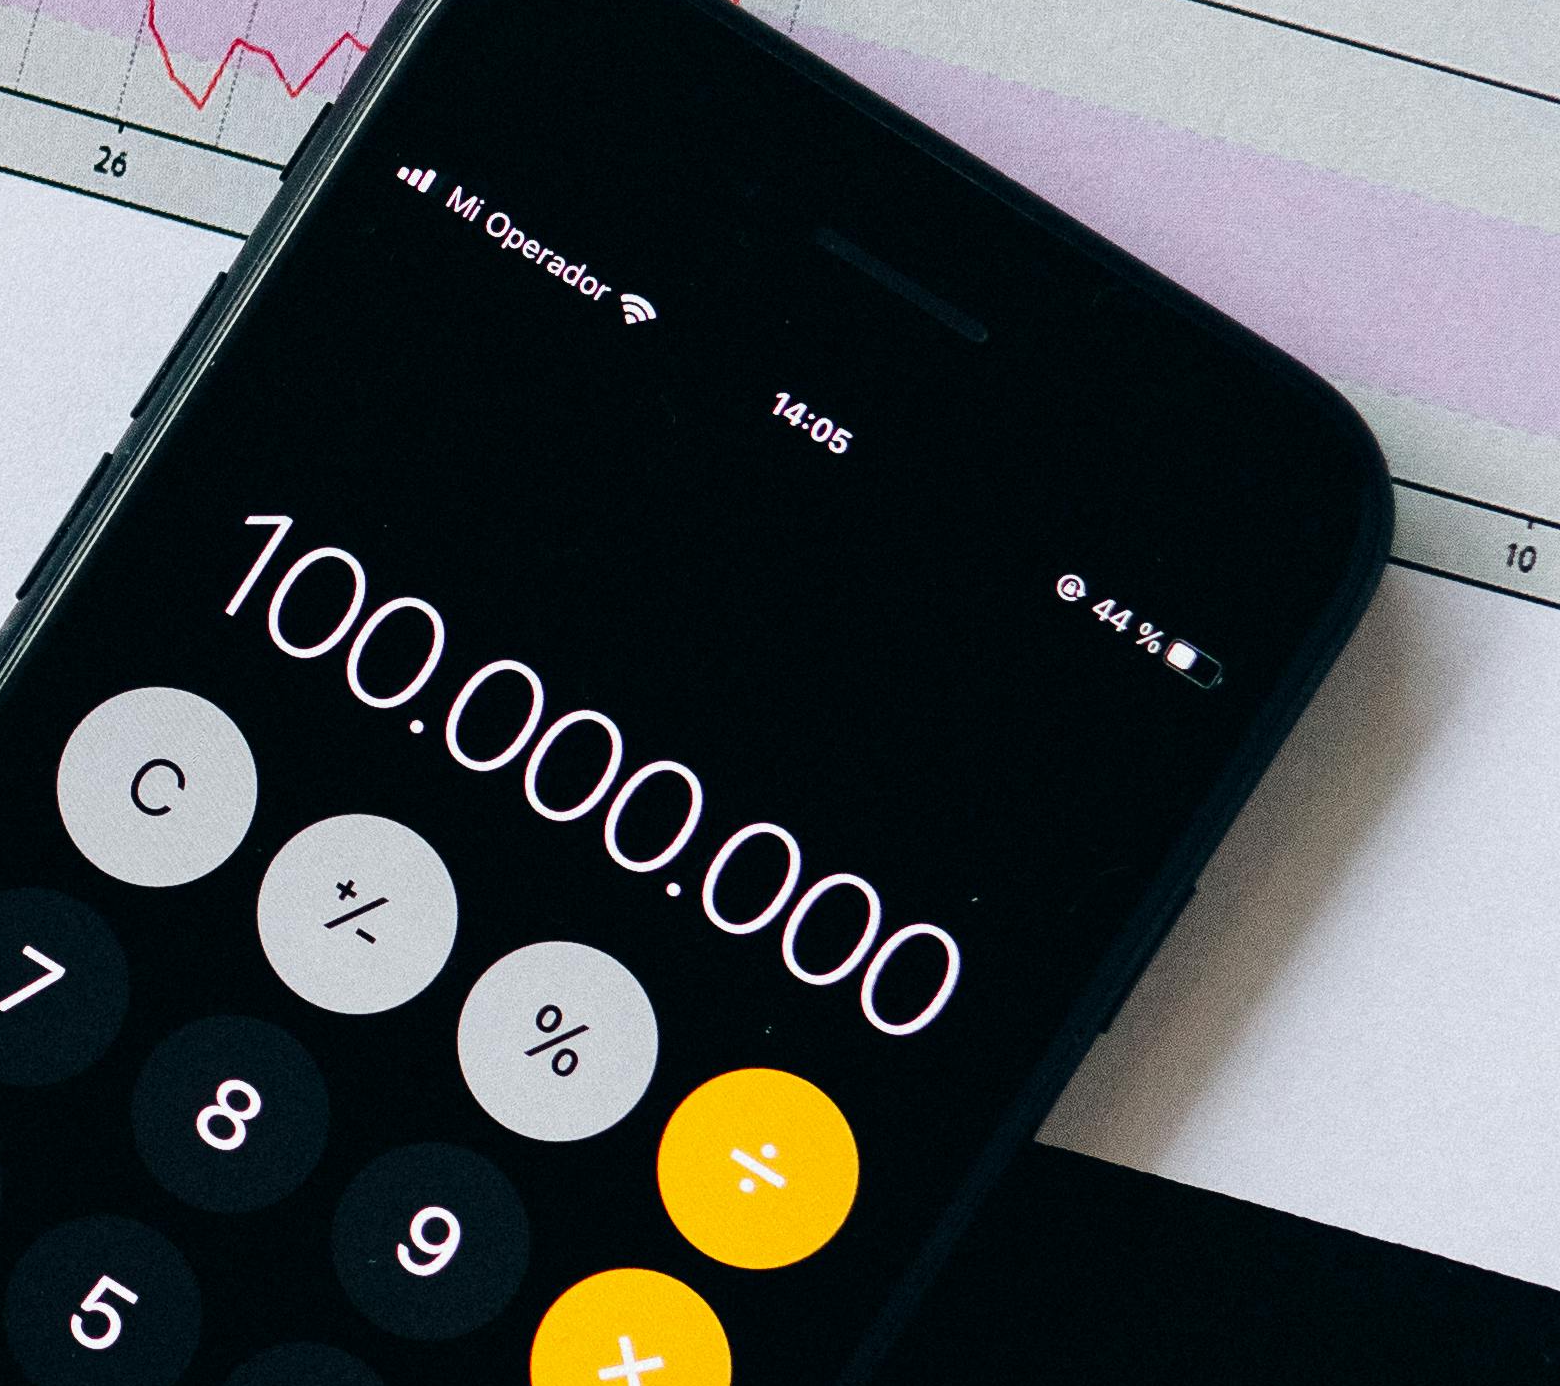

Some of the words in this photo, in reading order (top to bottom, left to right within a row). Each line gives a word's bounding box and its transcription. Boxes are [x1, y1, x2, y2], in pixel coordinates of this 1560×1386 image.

[92, 144, 129, 179] 26
[445, 184, 487, 223] Mi
[483, 211, 612, 305] Operador
[771, 391, 856, 456] 14:05
[1506, 541, 1538, 574] 10
[1090, 596, 1135, 635] 44
[129, 758, 187, 818] C
[225, 514, 962, 1037] 100.000.000
[523, 1003, 590, 1078] %
[195, 1079, 265, 1152] 8
[395, 1206, 463, 1279] 9
[69, 1273, 140, 1352] 5
